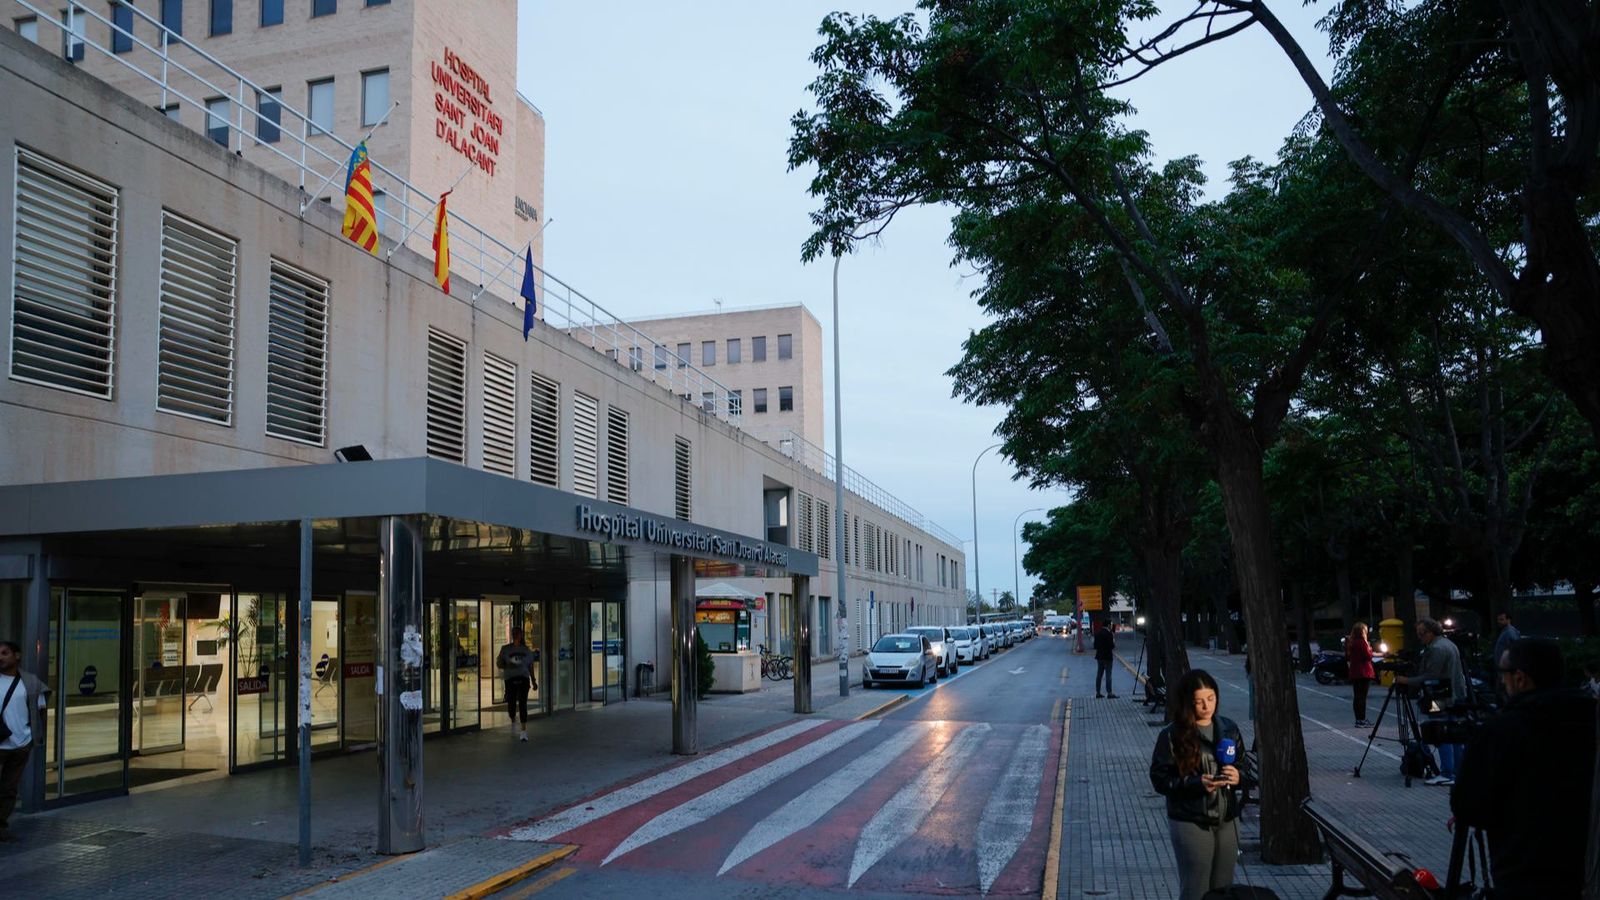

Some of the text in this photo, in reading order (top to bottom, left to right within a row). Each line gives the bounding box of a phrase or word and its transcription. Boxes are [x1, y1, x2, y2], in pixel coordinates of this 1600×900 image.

[431, 60, 503, 136] UNIVERSITARI
[444, 46, 493, 104] HOSPITAL
[435, 91, 499, 156] SANT JOAN
[436, 117, 497, 177] D'ALACANT
[577, 503, 644, 540] Hospital
[646, 518, 714, 552] Universitari
[715, 535, 736, 557] Sant
[239, 680, 268, 691] SALIDA
